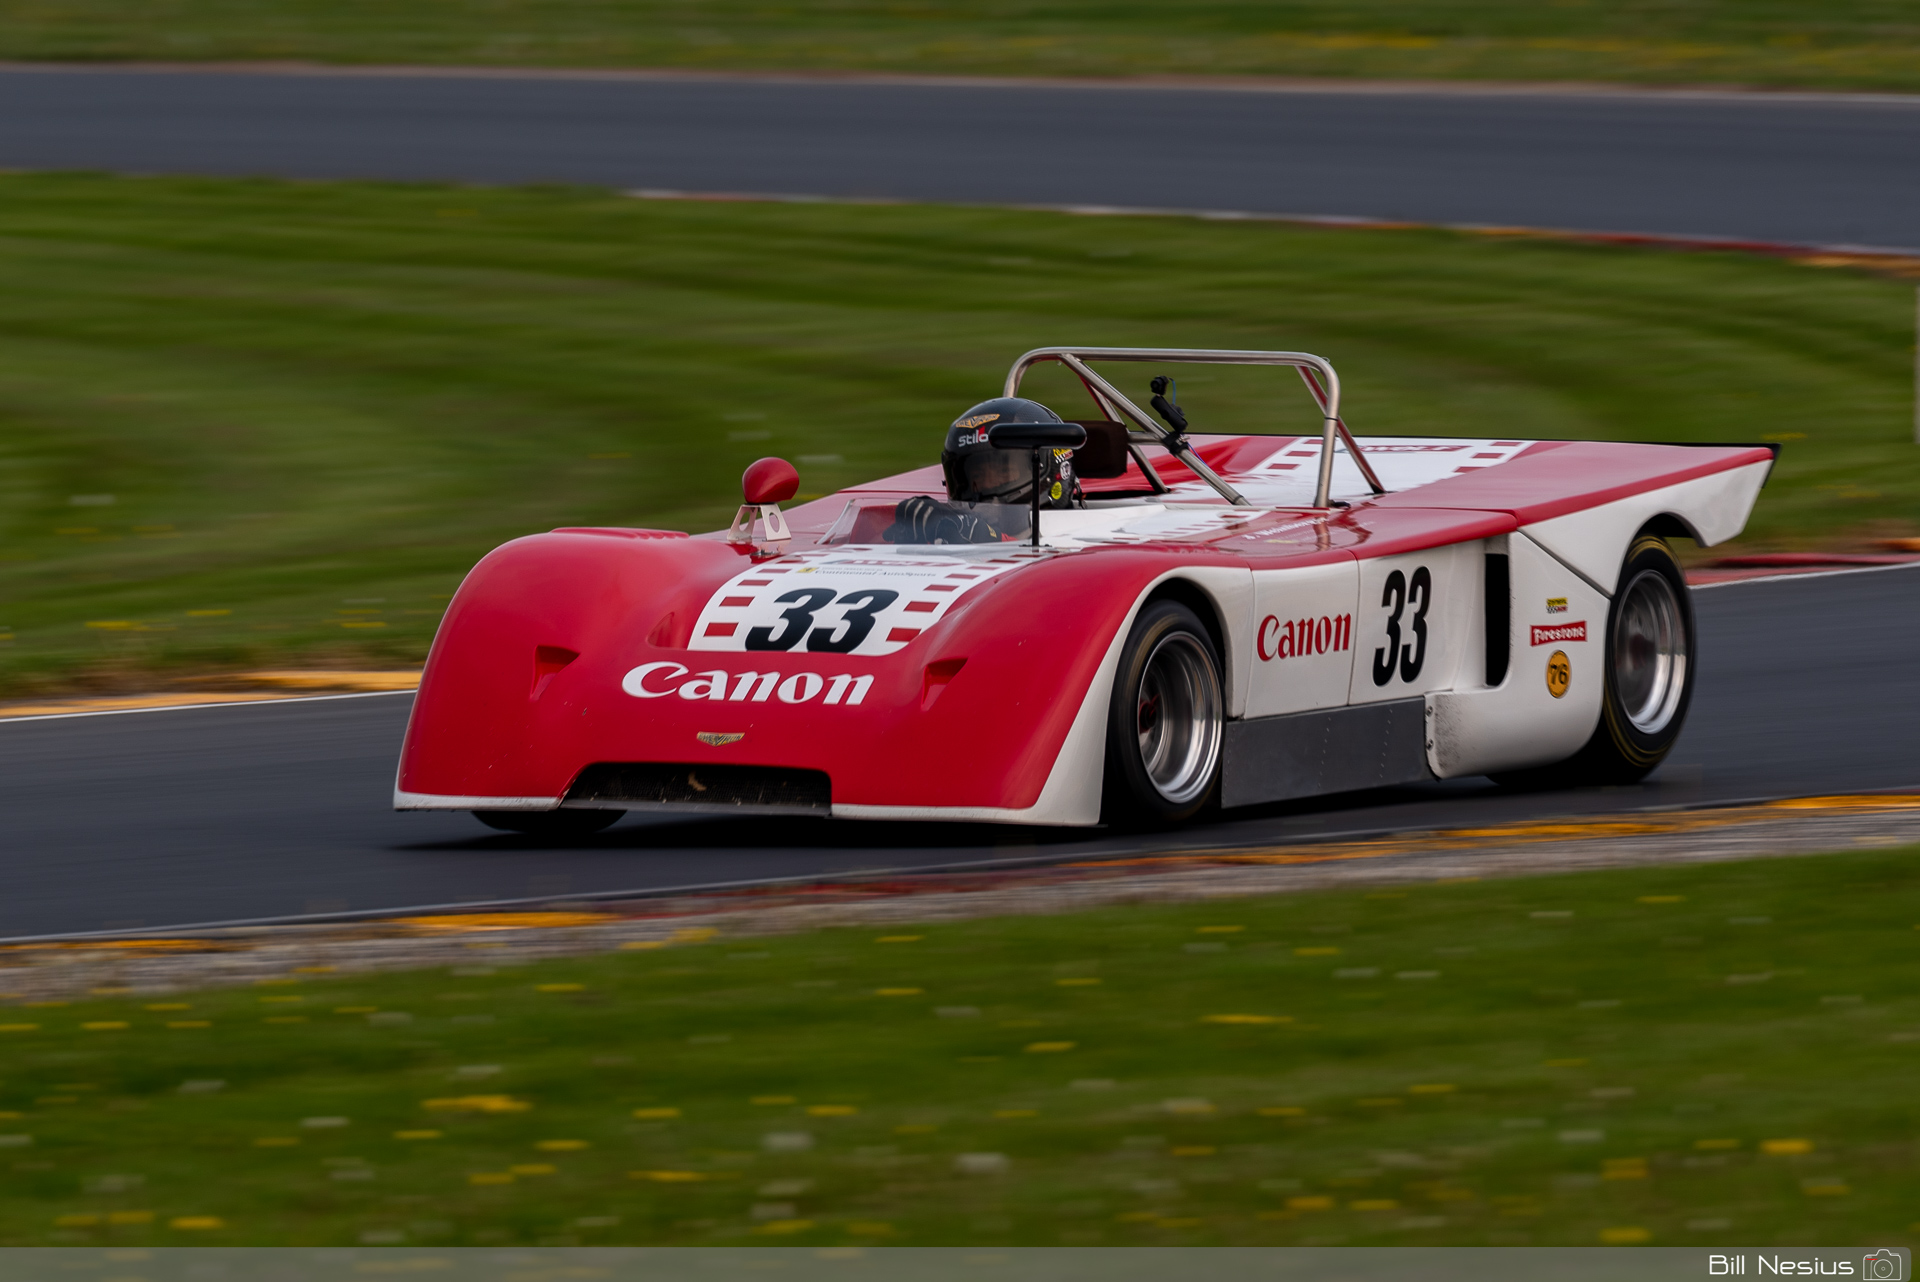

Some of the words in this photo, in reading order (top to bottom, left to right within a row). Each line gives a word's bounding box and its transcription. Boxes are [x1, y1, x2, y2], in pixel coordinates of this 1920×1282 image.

[958, 429, 989, 447] stilo
[745, 587, 900, 654] 33
[1257, 613, 1352, 662] Canon
[1372, 565, 1432, 687] 33
[1532, 626, 1586, 645] Firestone
[622, 661, 875, 706] Canon
[1549, 663, 1568, 685] 76
